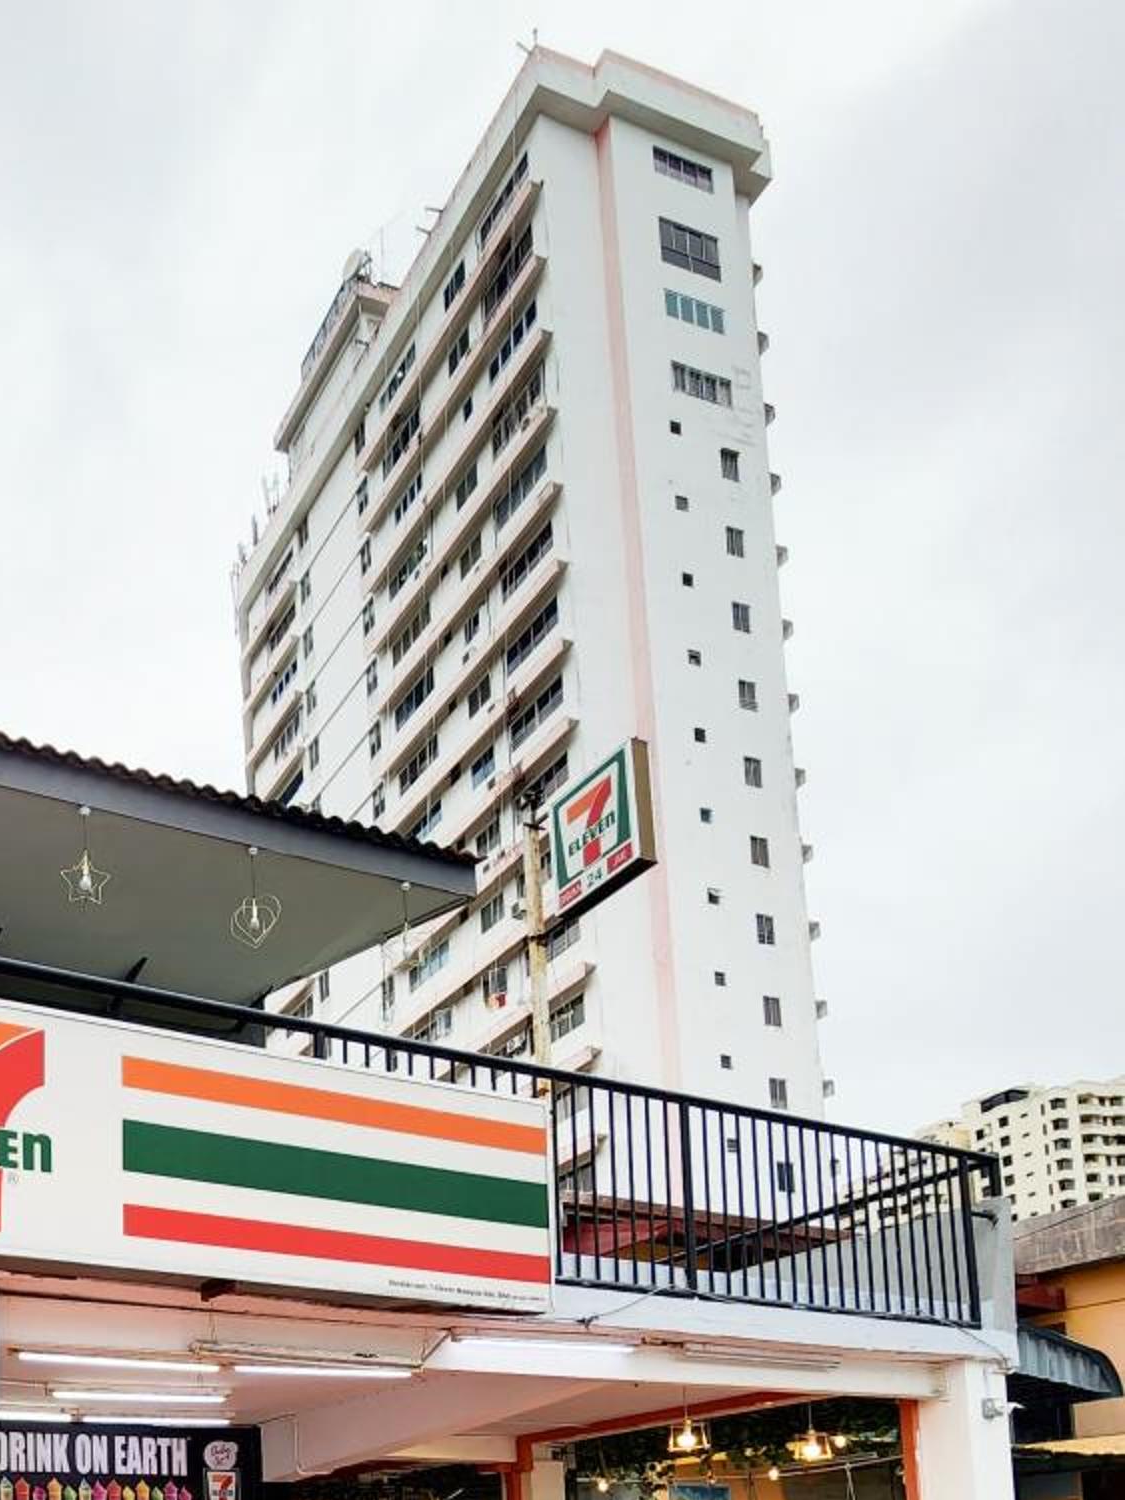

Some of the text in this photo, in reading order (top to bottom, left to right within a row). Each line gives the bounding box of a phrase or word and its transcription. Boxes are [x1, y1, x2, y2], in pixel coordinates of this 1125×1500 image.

[0, 1431, 70, 1473] DRINK
[74, 1435, 109, 1475] ON
[115, 1436, 188, 1477] EARTH
